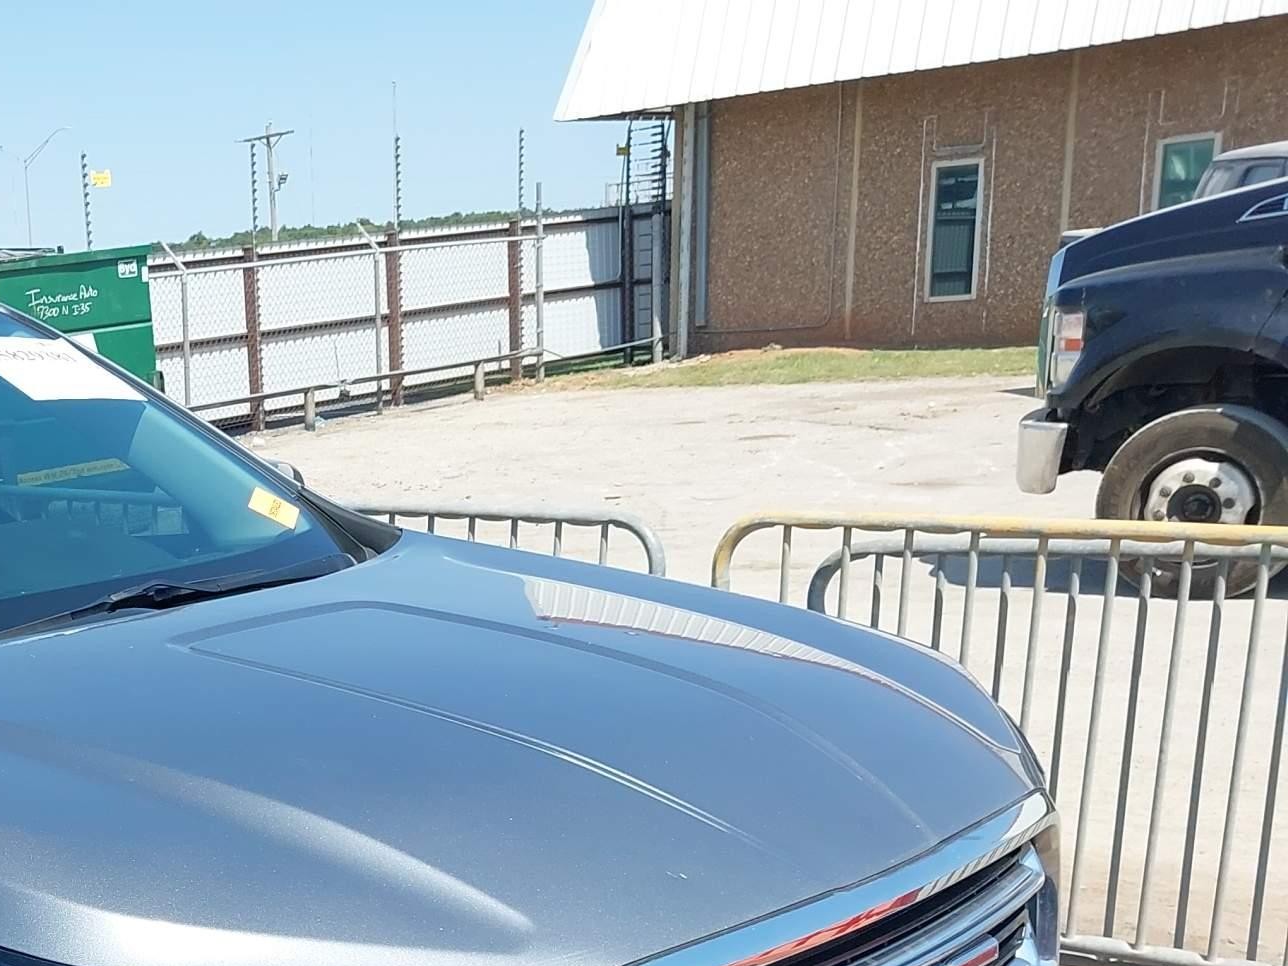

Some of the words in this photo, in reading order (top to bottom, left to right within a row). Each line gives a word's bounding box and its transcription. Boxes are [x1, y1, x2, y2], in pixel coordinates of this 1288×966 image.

[24, 288, 79, 307] Insurance
[79, 284, 98, 299] Auto
[37, 304, 60, 320] 7300
[61, 305, 69, 315] N
